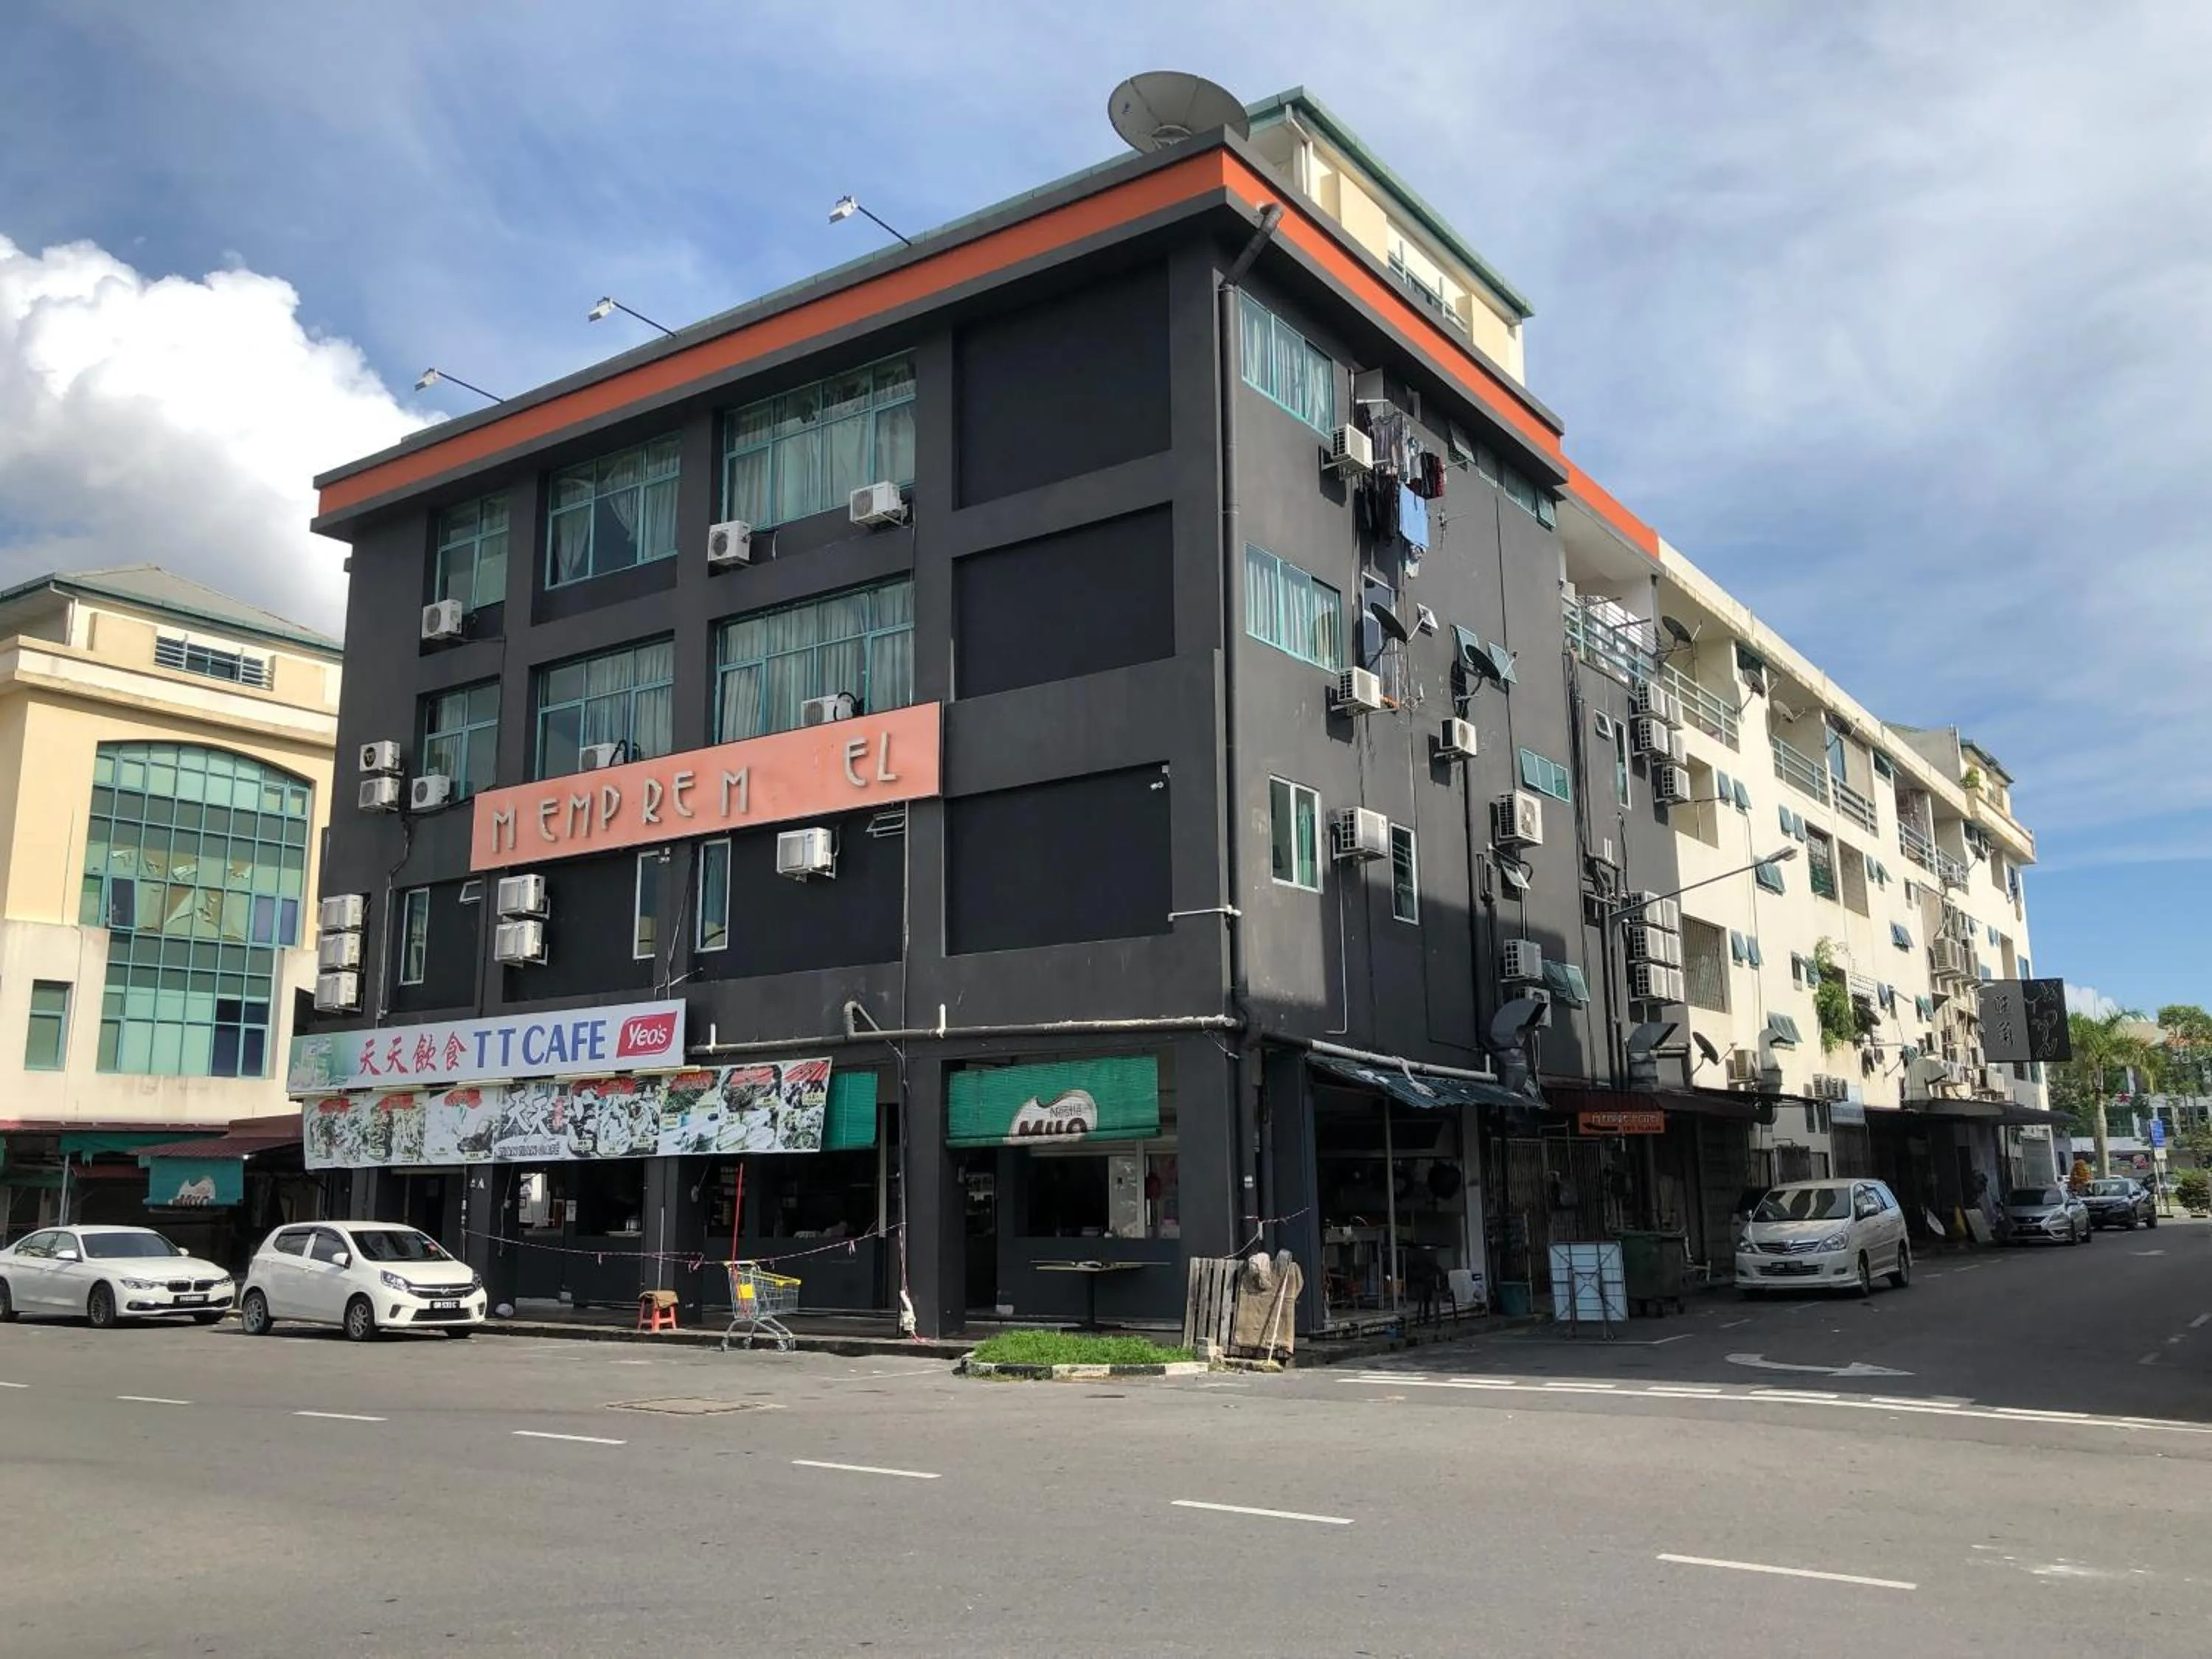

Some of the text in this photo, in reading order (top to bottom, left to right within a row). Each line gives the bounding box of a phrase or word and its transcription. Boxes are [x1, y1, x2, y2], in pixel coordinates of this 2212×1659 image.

[359, 1031, 467, 1076] 天天飲食
[627, 1023, 667, 1049] Yeo's
